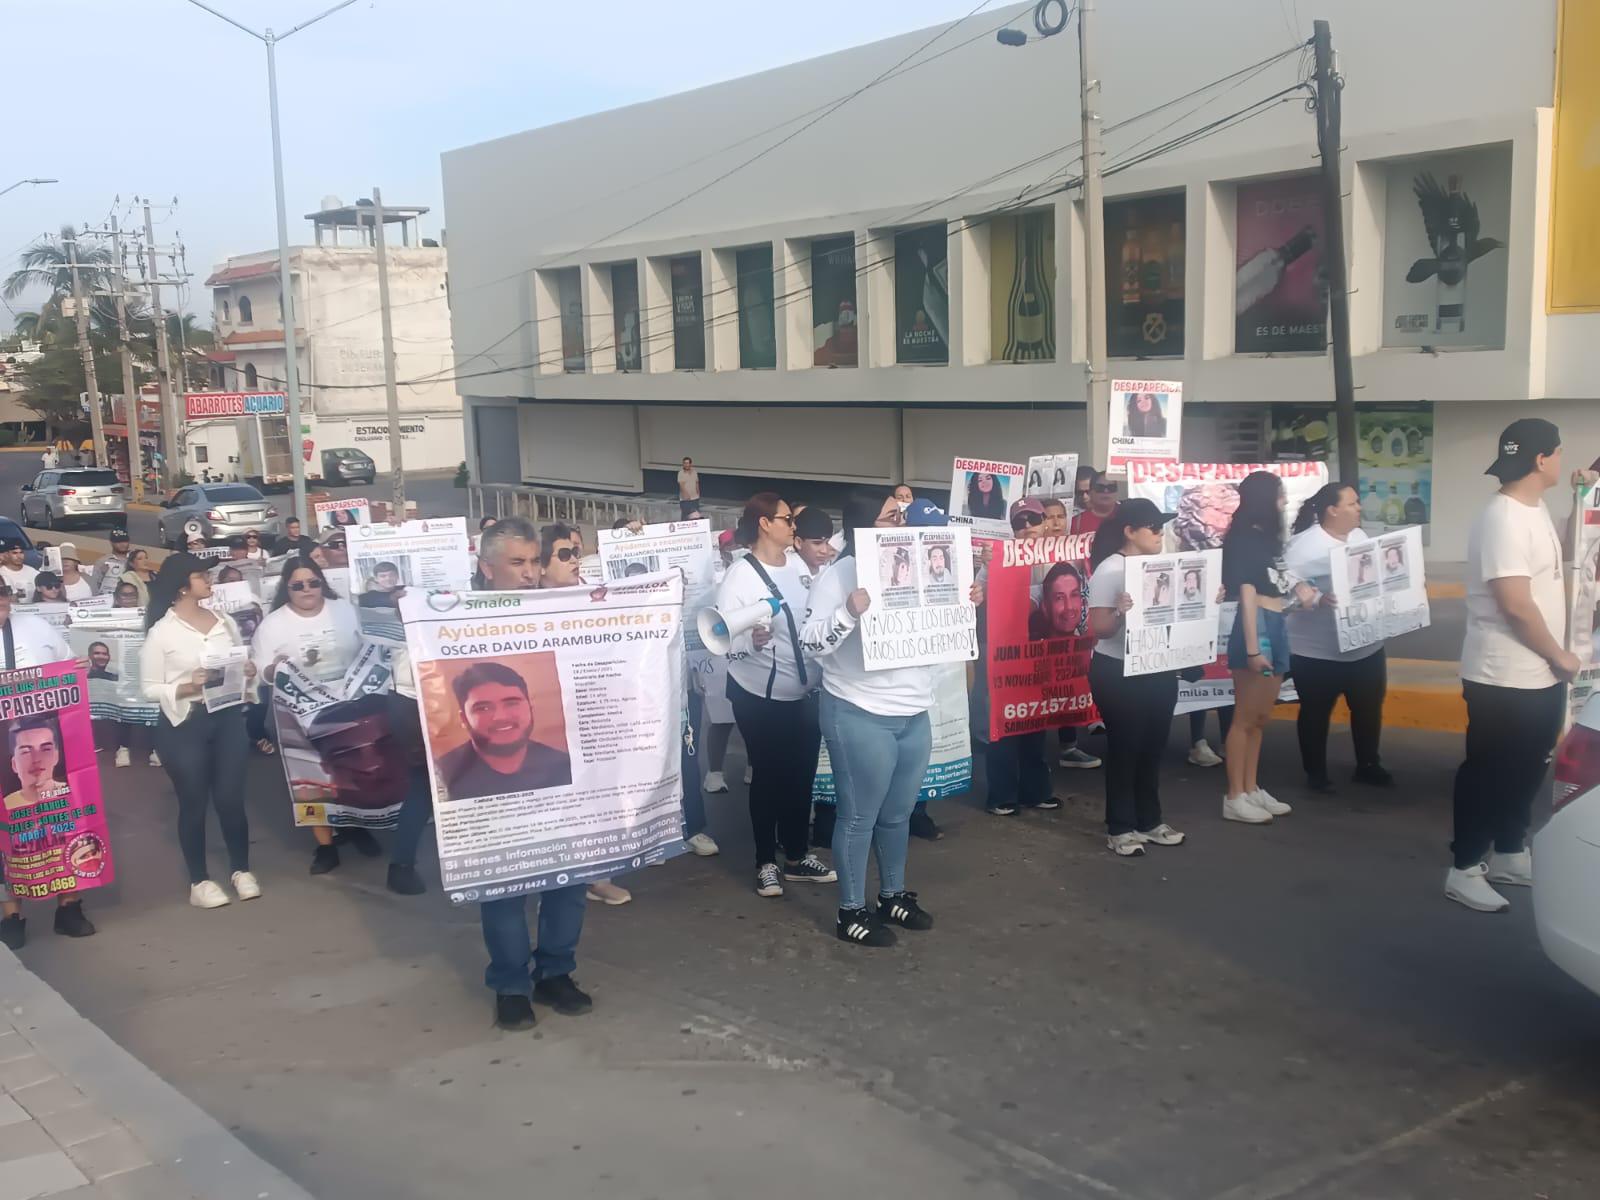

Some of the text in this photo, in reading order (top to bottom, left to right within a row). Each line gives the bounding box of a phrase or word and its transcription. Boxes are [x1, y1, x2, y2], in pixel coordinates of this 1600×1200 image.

[1256, 326, 1268, 336] ES
[1272, 326, 1286, 336] DE
[1114, 381, 1182, 393] DESAPARECIDA
[190, 392, 285, 416] ABARROTES ACUARIO
[956, 458, 1024, 476] DESAPARECIDA
[316, 498, 368, 512] DESAPARECIDA
[950, 516, 974, 525] CHINA
[464, 596, 521, 610] Sinaloa
[438, 612, 672, 641] Ayúdanos a encontrar a
[906, 610, 918, 634] SE
[921, 607, 938, 630] LOS
[440, 628, 670, 656] OSCAR DAVID ARAMBURO SAINZ
[896, 638, 916, 660] LOS
[1212, 686, 1224, 696] la
[50, 822, 76, 834] 2025
[445, 860, 458, 870] Si
[464, 855, 502, 868] tienes
[505, 843, 567, 860] información
[571, 834, 618, 849] referente
[446, 870, 480, 882] llama
[558, 853, 571, 862] Tu
[574, 848, 606, 860] ayuda
[622, 842, 642, 852] muy
